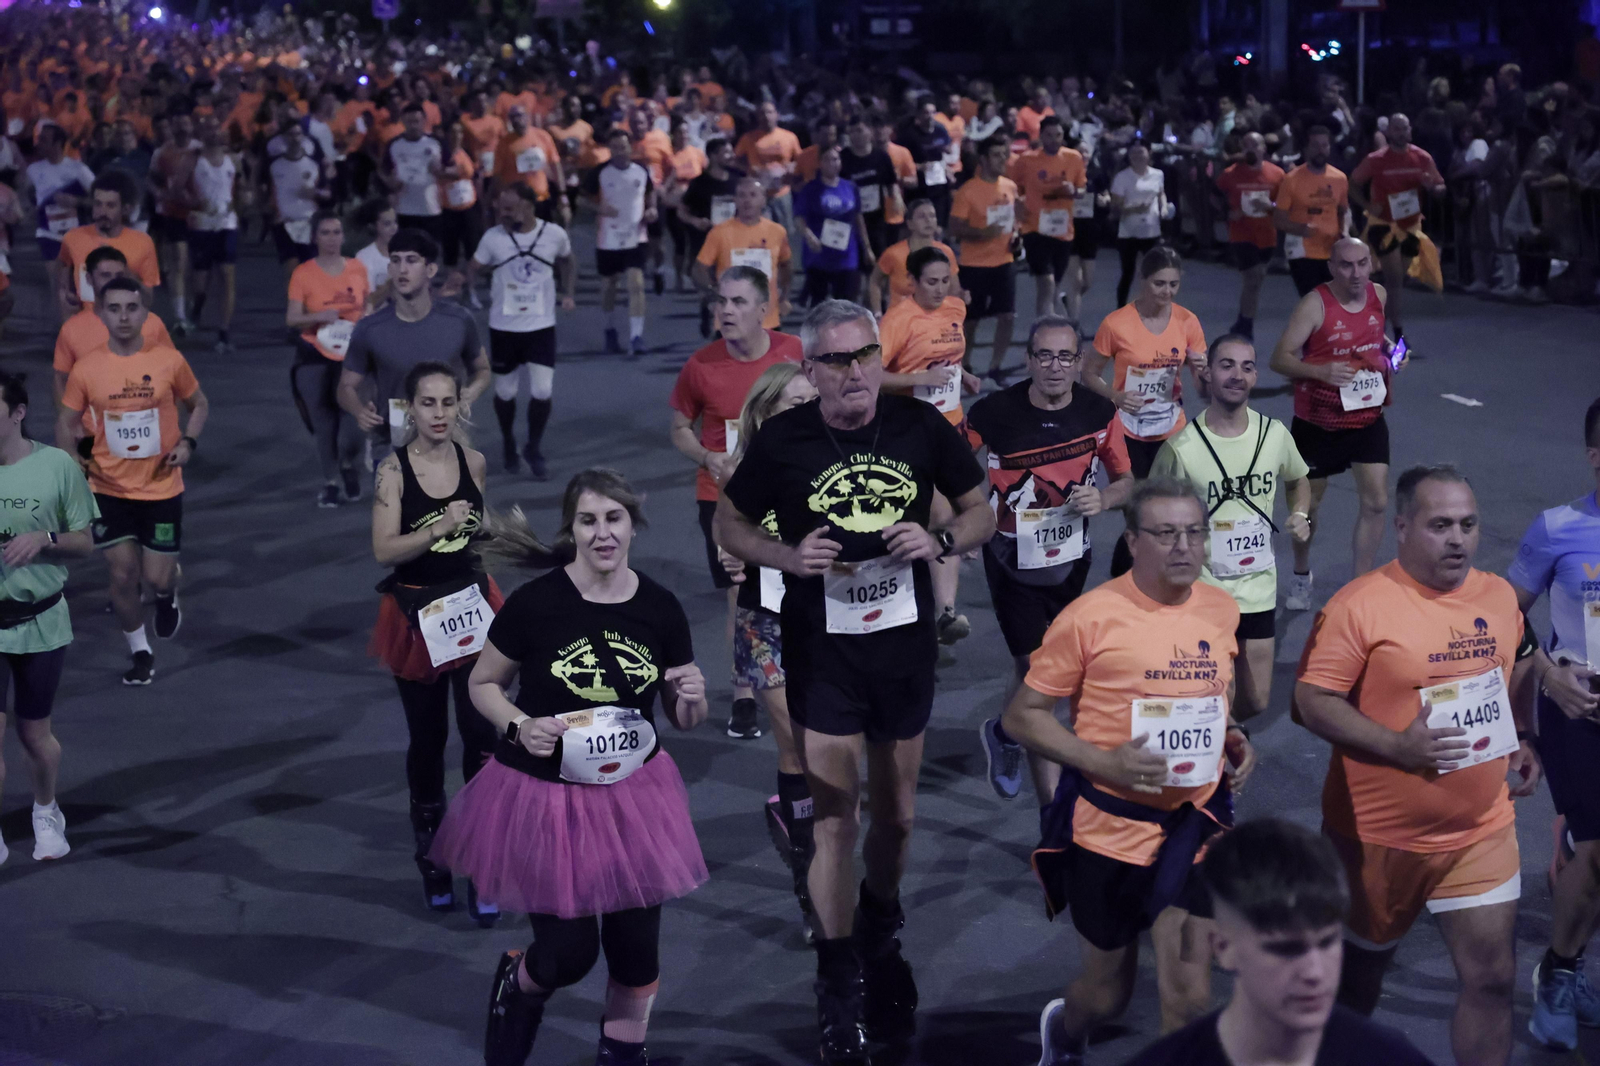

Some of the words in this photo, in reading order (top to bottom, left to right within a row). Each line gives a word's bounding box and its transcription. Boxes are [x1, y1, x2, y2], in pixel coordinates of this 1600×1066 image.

[1352, 377, 1379, 392] 21575
[117, 426, 150, 439] 19510
[1043, 440, 1095, 462] PANTANERAS
[850, 453, 876, 464] Club
[879, 455, 913, 478] Sevilla
[1034, 524, 1072, 544] 17180
[1226, 533, 1265, 552] 17242
[847, 577, 898, 604] 10255
[440, 607, 483, 635] 10171
[602, 630, 621, 642] lub
[624, 636, 653, 661] Sevilla
[1448, 636, 1497, 650] NOCTURNA
[1169, 660, 1218, 669] NOCTURNA
[1428, 650, 1471, 663] SEVILLA
[1473, 646, 1497, 659] KH7
[1144, 669, 1192, 680] SEVILLA
[1194, 669, 1218, 681] KH7
[1451, 700, 1500, 728] 14409
[585, 730, 639, 754] 10128
[1157, 728, 1212, 750] 10676
